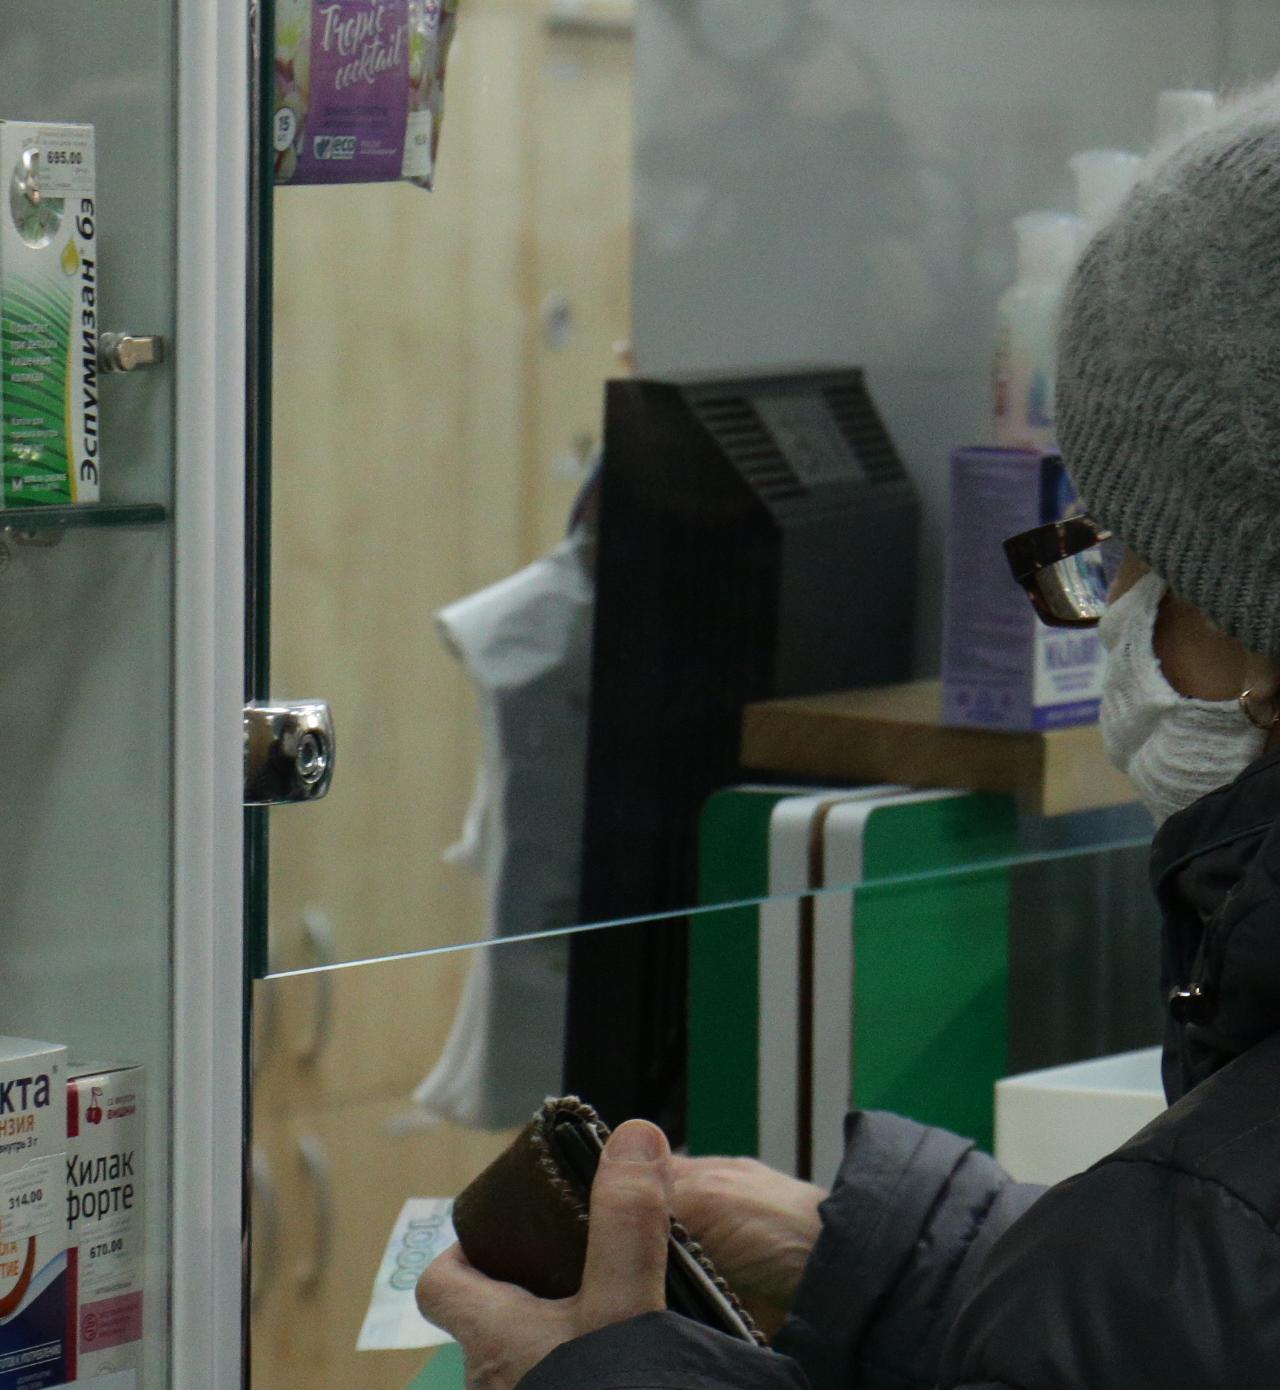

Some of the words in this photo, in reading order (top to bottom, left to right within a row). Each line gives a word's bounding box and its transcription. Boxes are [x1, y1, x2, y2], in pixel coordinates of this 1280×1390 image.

[81, 258, 98, 486] Эспумизан
[8, 1188, 44, 1210] 314.00
[89, 1238, 123, 1260] 670.00
